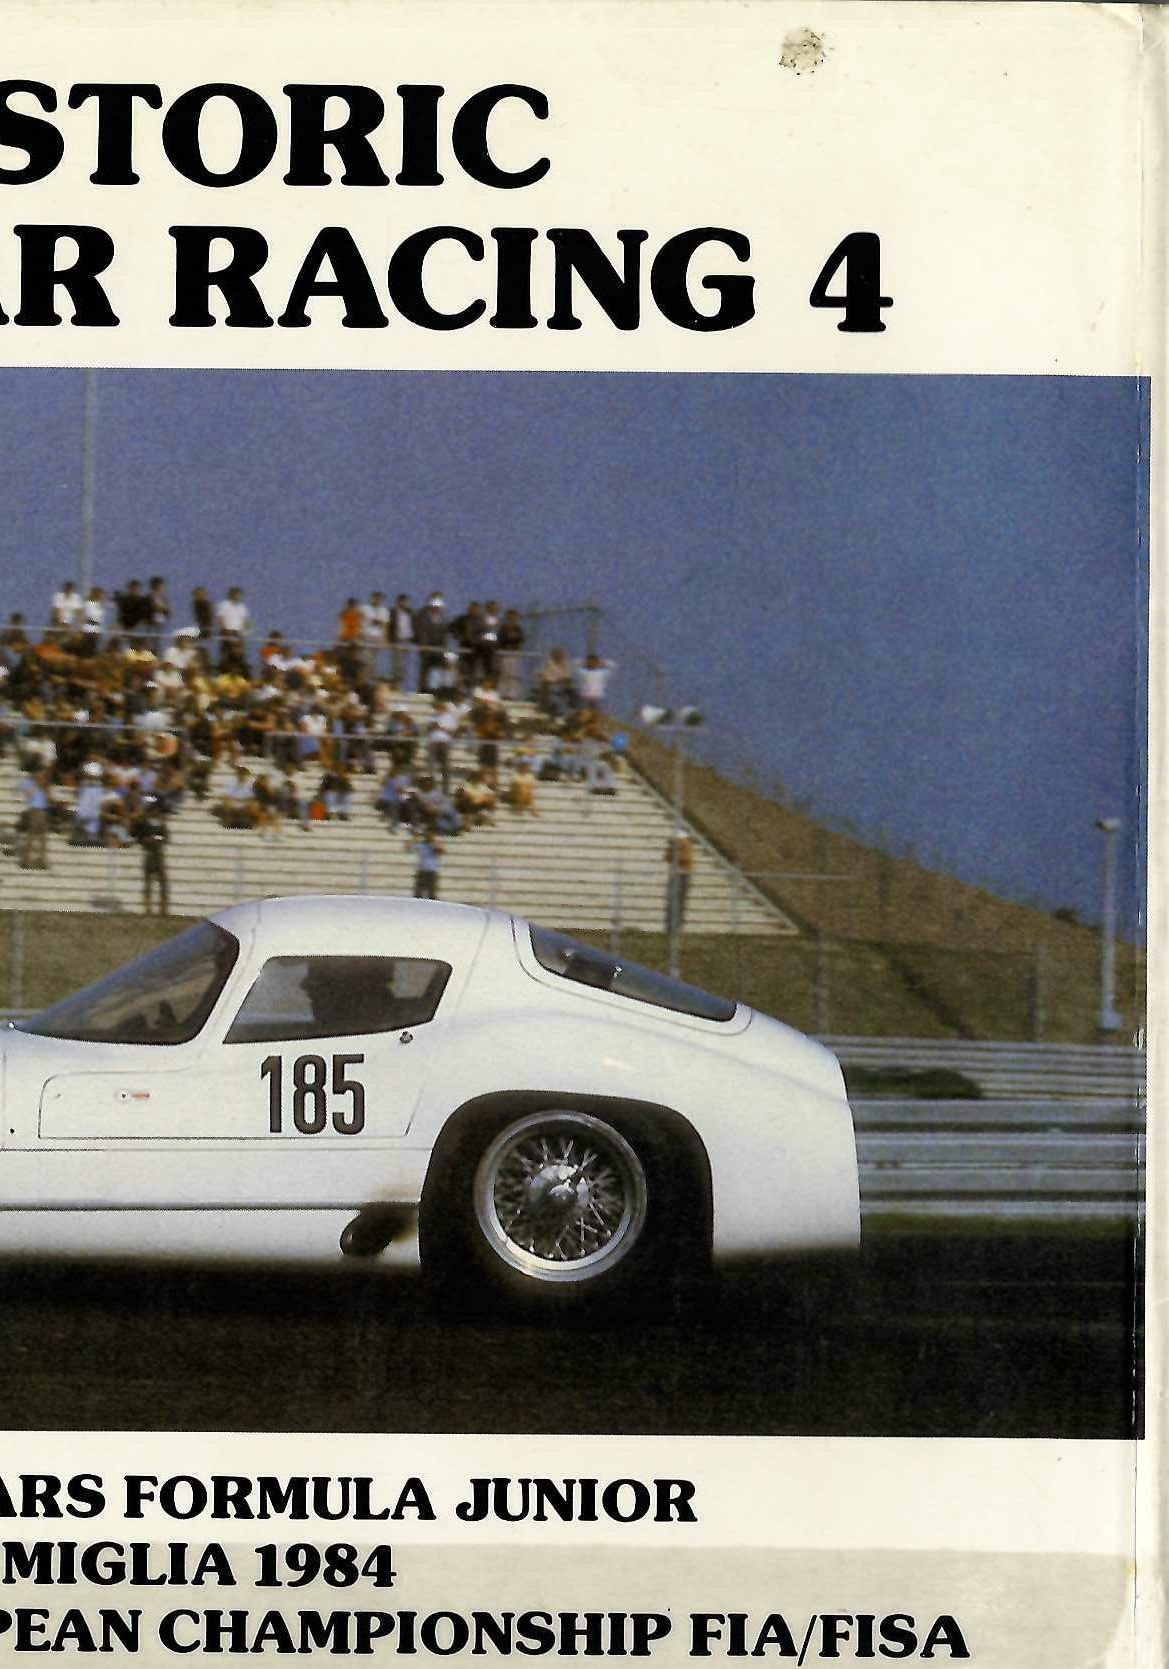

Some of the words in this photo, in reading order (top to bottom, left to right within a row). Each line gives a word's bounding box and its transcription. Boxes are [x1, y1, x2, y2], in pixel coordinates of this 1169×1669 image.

[169, 225, 756, 333] RACING
[809, 231, 895, 333] 4
[260, 1053, 366, 1136] 185
[123, 1475, 437, 1521] FORMULA
[455, 1477, 699, 1523] JUNIOR
[1, 1541, 237, 1586] MIGLIA
[254, 1543, 398, 1588] 1984
[158, 1608, 672, 1657] CHAMPIONSHIP
[689, 1612, 971, 1665] FIA/FISA
